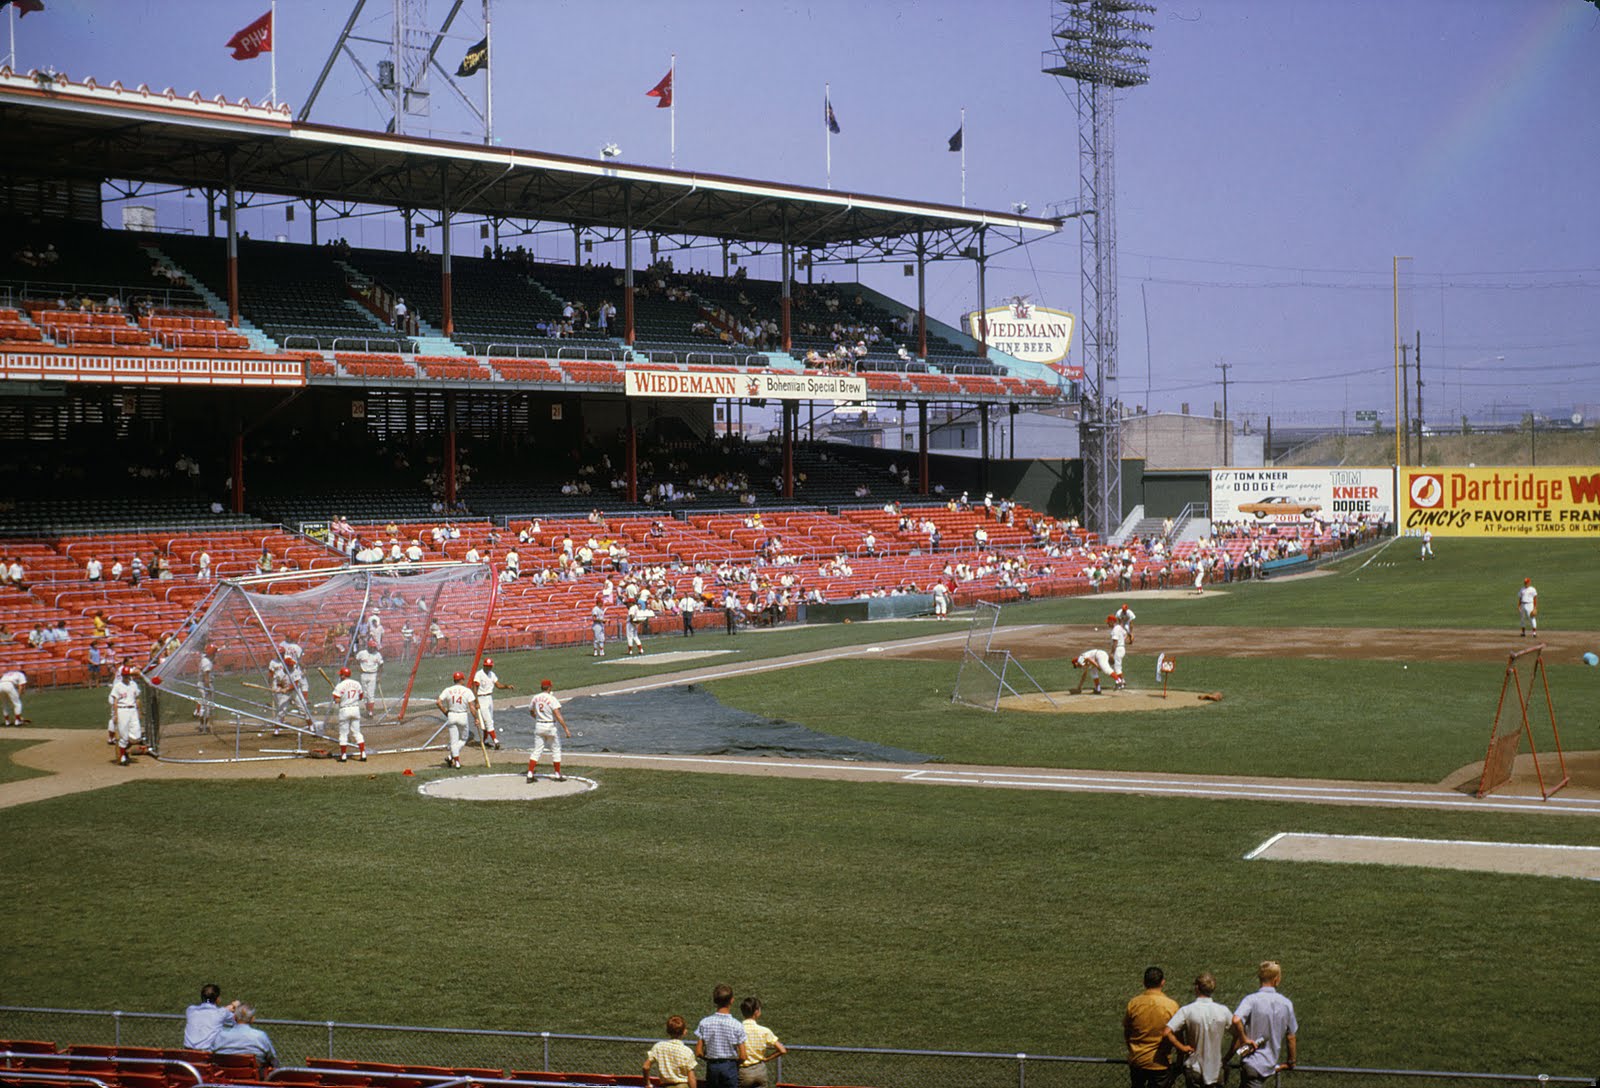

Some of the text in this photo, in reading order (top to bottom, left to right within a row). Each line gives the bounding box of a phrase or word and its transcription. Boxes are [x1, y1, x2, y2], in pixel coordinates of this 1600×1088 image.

[995, 343, 1053, 353] FINE BEER
[634, 372, 736, 395] WIEDEMANN
[767, 377, 861, 395] Bohemian Special Brew
[352, 404, 364, 415] 20
[553, 407, 561, 417] 21
[1234, 472, 1255, 480] TOM
[1259, 472, 1288, 480] KNEER
[1330, 471, 1361, 485] TOM
[1234, 482, 1275, 491] DODGE
[1451, 473, 1562, 508] Partridge
[1332, 486, 1379, 499] KNEER
[1333, 500, 1370, 512] DODGE
[1406, 509, 1472, 528] CINCY'S
[1474, 510, 1552, 522] FAVORITE
[1484, 523, 1600, 534] AT Partridge STANDS ON LOW
[347, 690, 357, 699] 17
[452, 695, 462, 704] 14
[539, 703, 545, 712] 2
